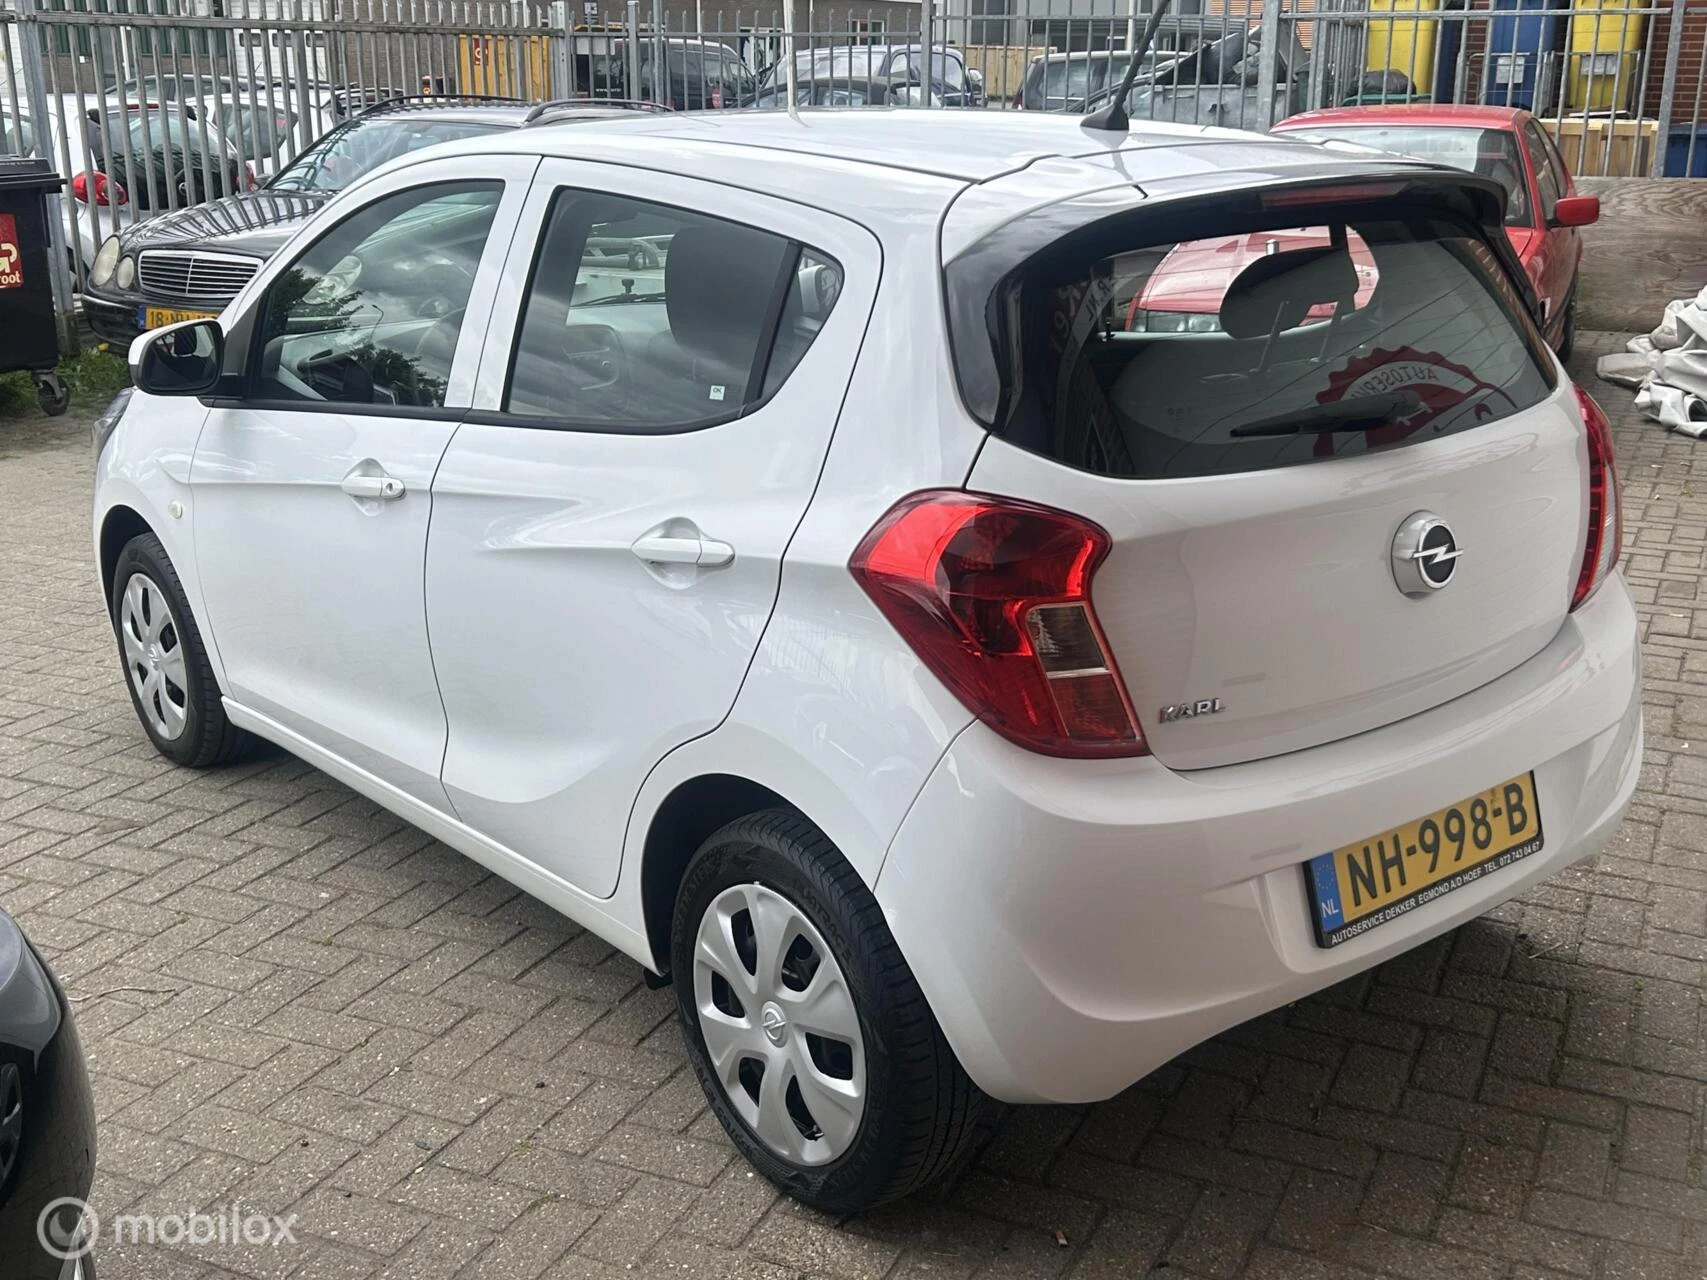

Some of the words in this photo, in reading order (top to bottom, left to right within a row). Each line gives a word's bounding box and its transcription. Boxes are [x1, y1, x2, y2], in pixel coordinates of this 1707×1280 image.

[1158, 697, 1226, 724] KARL
[1347, 783, 1528, 907] NH-998-B
[1321, 898, 1339, 919] NL
[1331, 913, 1385, 945] AUTOSERVICE
[1385, 898, 1416, 919] DEKKER
[1418, 882, 1450, 904] EGMOND
[1463, 867, 1482, 883] HOEF
